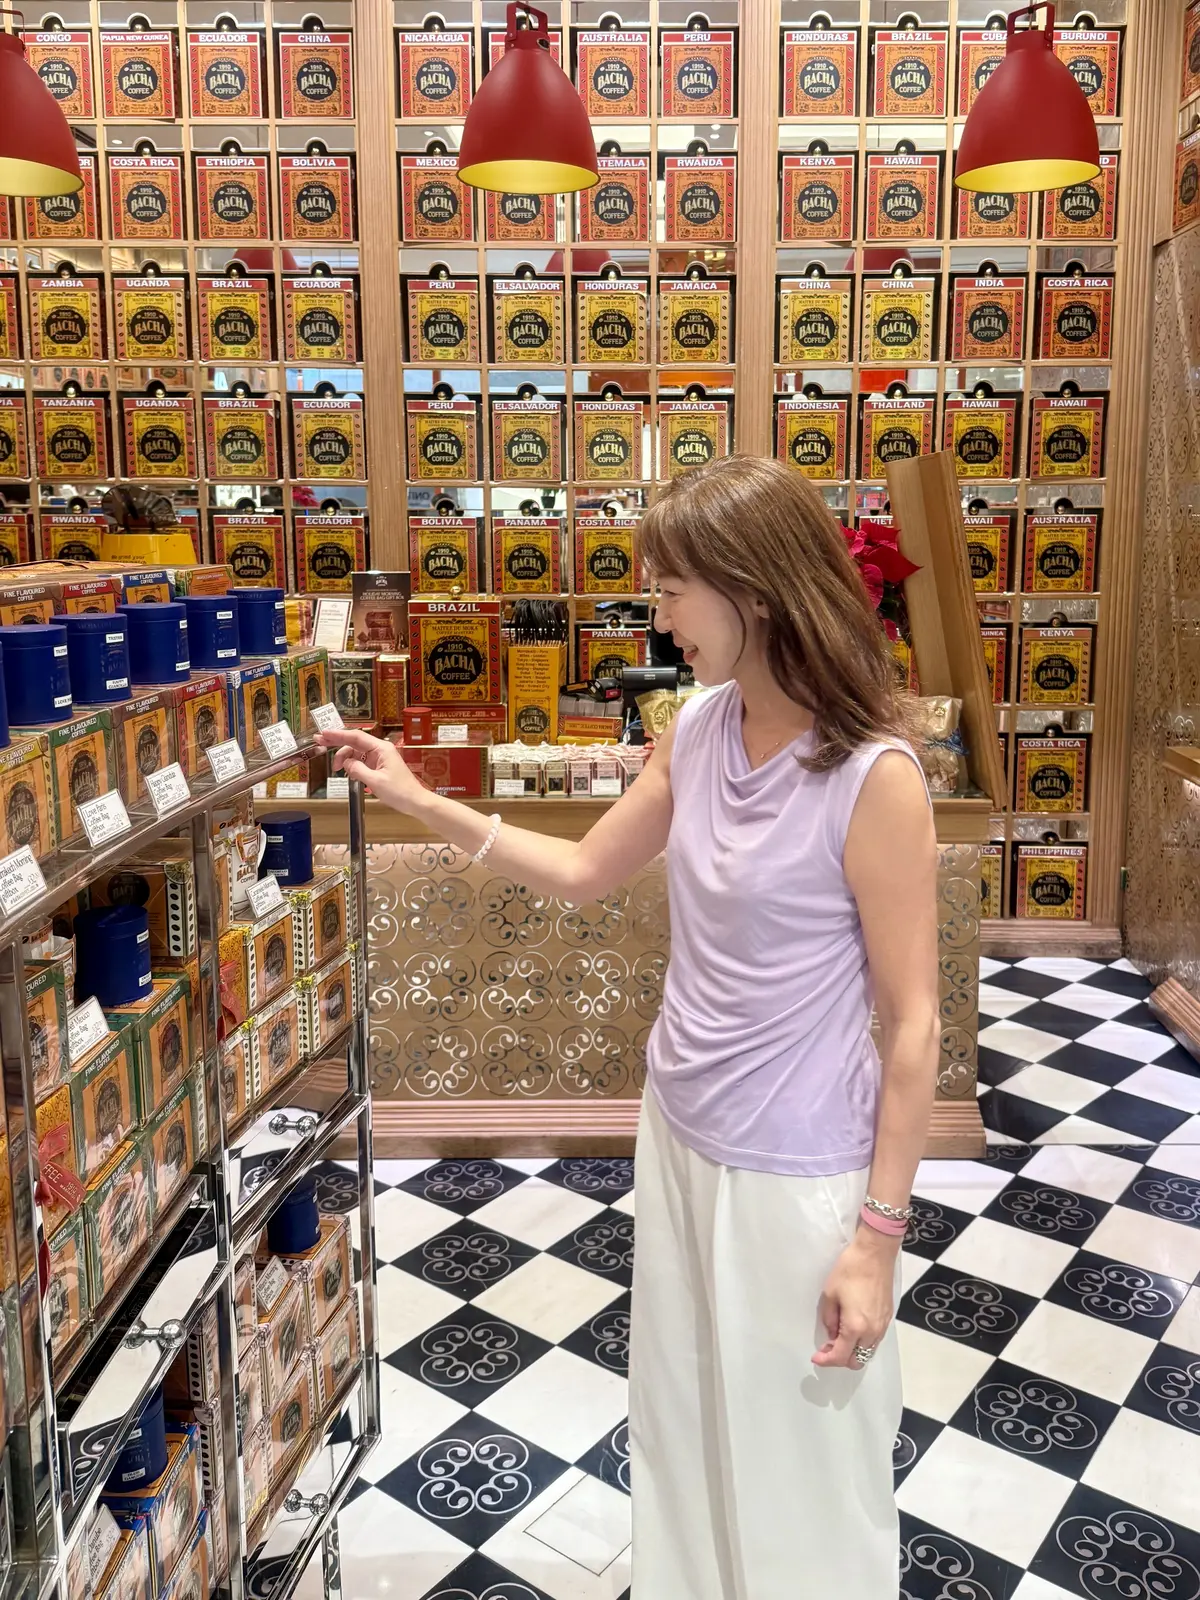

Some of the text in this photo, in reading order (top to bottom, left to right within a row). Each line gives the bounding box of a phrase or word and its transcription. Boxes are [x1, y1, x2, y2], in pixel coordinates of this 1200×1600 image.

[199, 34, 248, 42] ECUADOR
[405, 33, 464, 42] NICARAGUA
[582, 33, 643, 42] AUSTRALIA
[684, 33, 710, 42] PERU
[792, 33, 848, 41] HONDURAS
[891, 32, 932, 40] BRAZIL
[1060, 32, 1107, 40] BURUNDI
[301, 72, 332, 90] BACHA
[420, 72, 451, 90] BACHA
[682, 72, 713, 90] BACHA
[804, 72, 835, 89] BACHA
[894, 71, 925, 89] BACHA
[425, 87, 448, 95] COFFEE
[112, 158, 174, 167] COSTA RICA
[205, 158, 255, 166] ETHIOPIA
[292, 159, 336, 167] BOLIVIA
[416, 159, 457, 167] MEXICO
[677, 158, 723, 167] RWANDA
[800, 157, 836, 165] KENYA
[884, 156, 922, 165] HAWAII
[301, 196, 331, 213] BACHA
[212, 280, 252, 288] BRAZIL
[429, 281, 455, 289] PERU
[495, 282, 560, 290] EL SALVADOR
[584, 282, 639, 290] HONDURAS
[670, 282, 717, 290] JAMAICA
[304, 321, 335, 338] BACHA
[428, 322, 459, 340] BACHA
[798, 320, 830, 339] BACHA
[41, 399, 95, 407] TANZANIA
[136, 399, 179, 408] UGANDA
[218, 399, 258, 407] BRAZIL
[303, 400, 350, 408] ECUADOR
[427, 401, 453, 409] PERU
[495, 402, 558, 410] EL SALVADOR
[582, 402, 635, 411] HONDURAS
[784, 402, 839, 410] INDONESIA
[872, 400, 925, 409] THAILAND
[962, 400, 999, 408] HAWAII
[1050, 399, 1087, 407] HAWAII
[593, 441, 623, 459] BACHA
[1050, 439, 1080, 456] BACHA
[52, 516, 96, 524] RWANDA
[228, 516, 267, 525] BRAZIL
[305, 517, 352, 526] ECUADOR
[421, 518, 462, 526] BOLIVIA
[504, 518, 547, 526] PANAMA
[1032, 516, 1092, 524] AUSTRALIA
[234, 554, 265, 571] BACHA
[428, 555, 459, 573] BACHA
[1043, 555, 1075, 572] BACHA
[17, 587, 45, 596] FLAVOURED
[427, 602, 480, 613] BRAZIL
[591, 630, 633, 638] PANAMA
[1039, 629, 1074, 637] KENYA
[435, 654, 476, 675] BACHA
[136, 696, 158, 708] FLAVOURED
[59, 718, 96, 736] FINE FLAVOURED
[1022, 740, 1081, 748] COSTA RICA
[1021, 847, 1082, 856] PHILIPPINES
[15, 855, 33, 870] Morning
[14, 873, 23, 882] Bag
